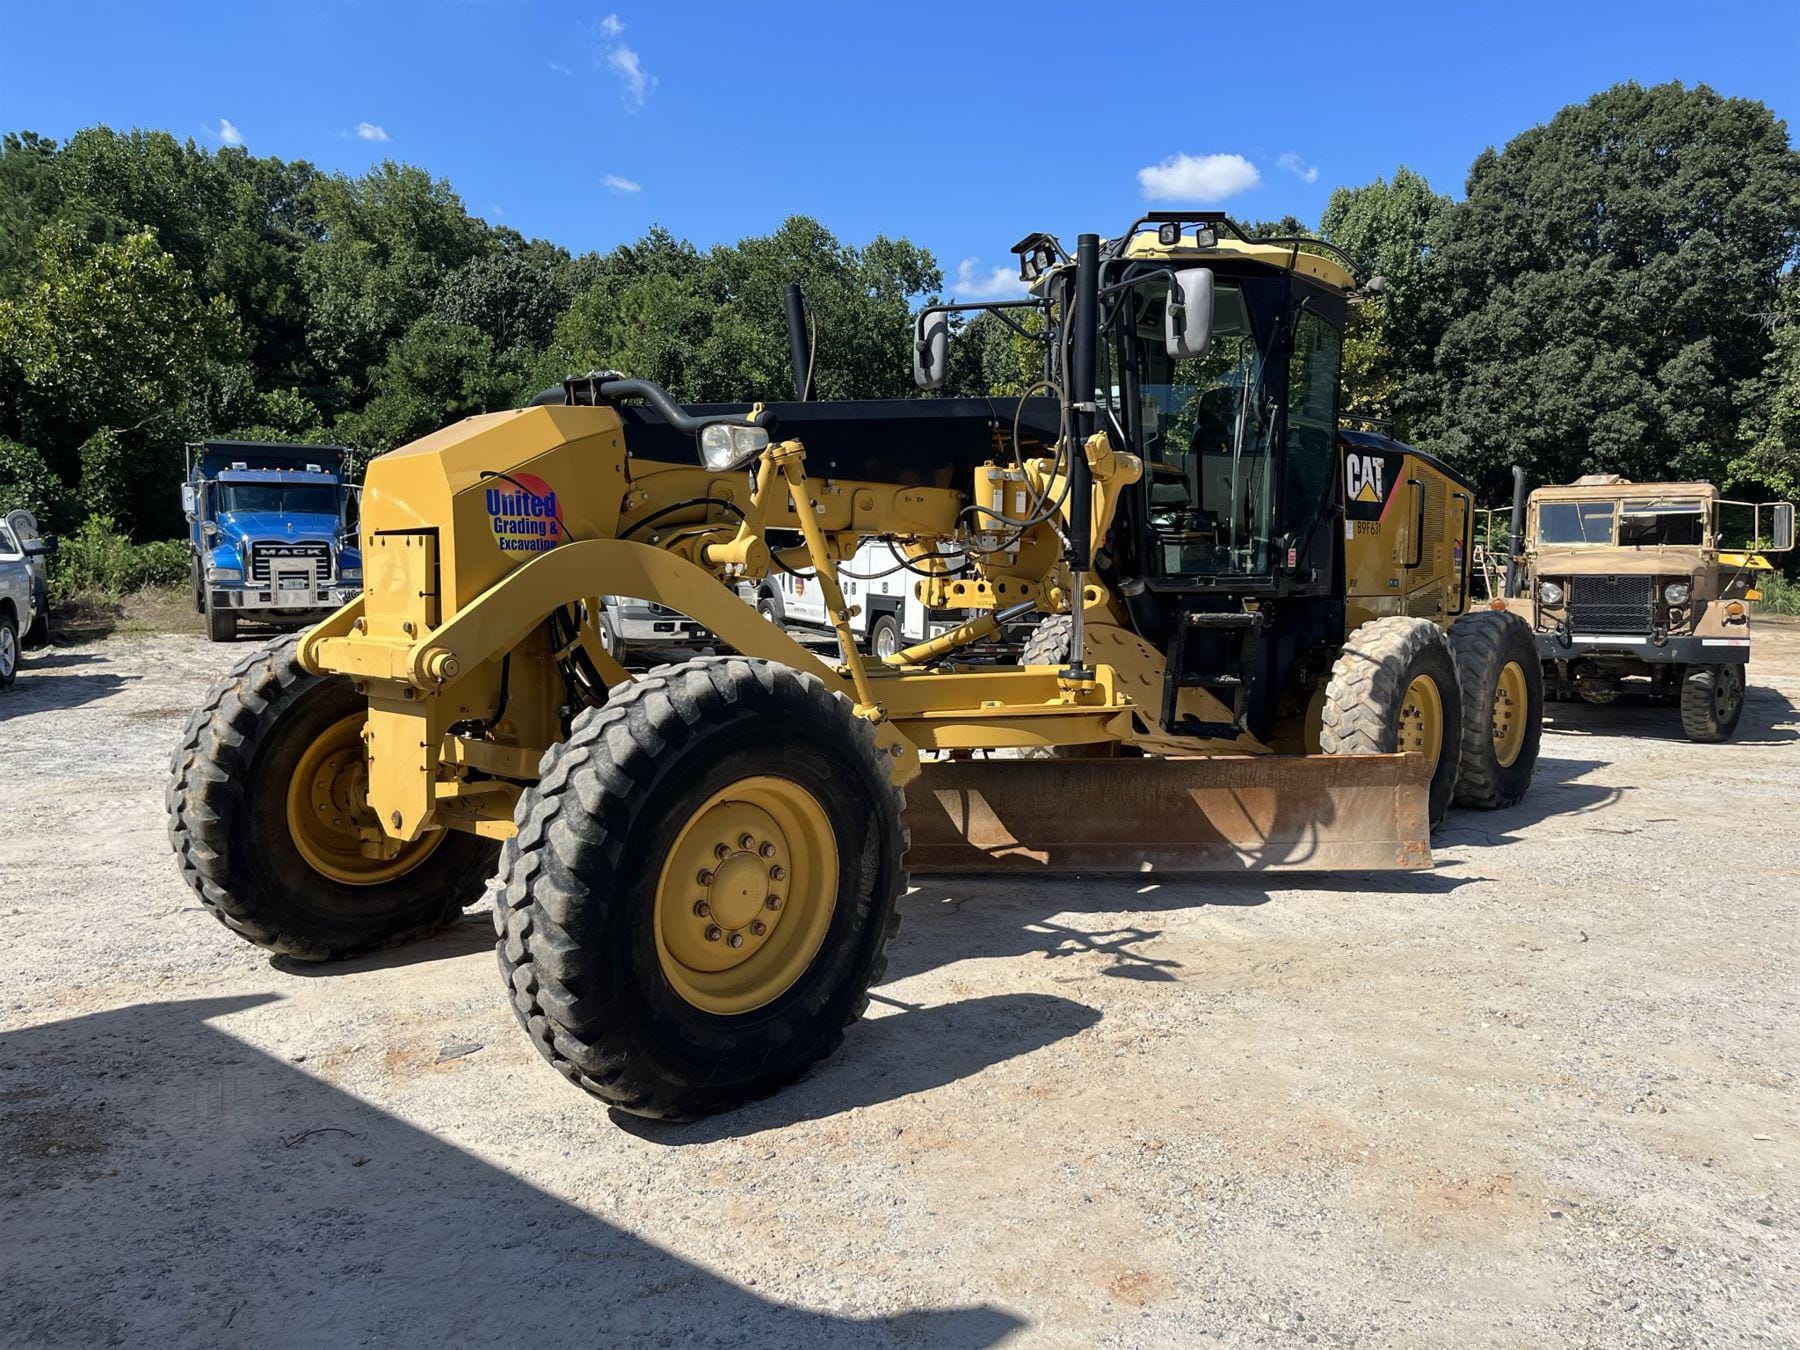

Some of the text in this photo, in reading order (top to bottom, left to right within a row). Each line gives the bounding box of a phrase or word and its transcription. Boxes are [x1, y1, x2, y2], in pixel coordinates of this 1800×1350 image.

[1346, 453, 1385, 503] CAT
[486, 489, 556, 517] United
[494, 517, 558, 537] Grading &
